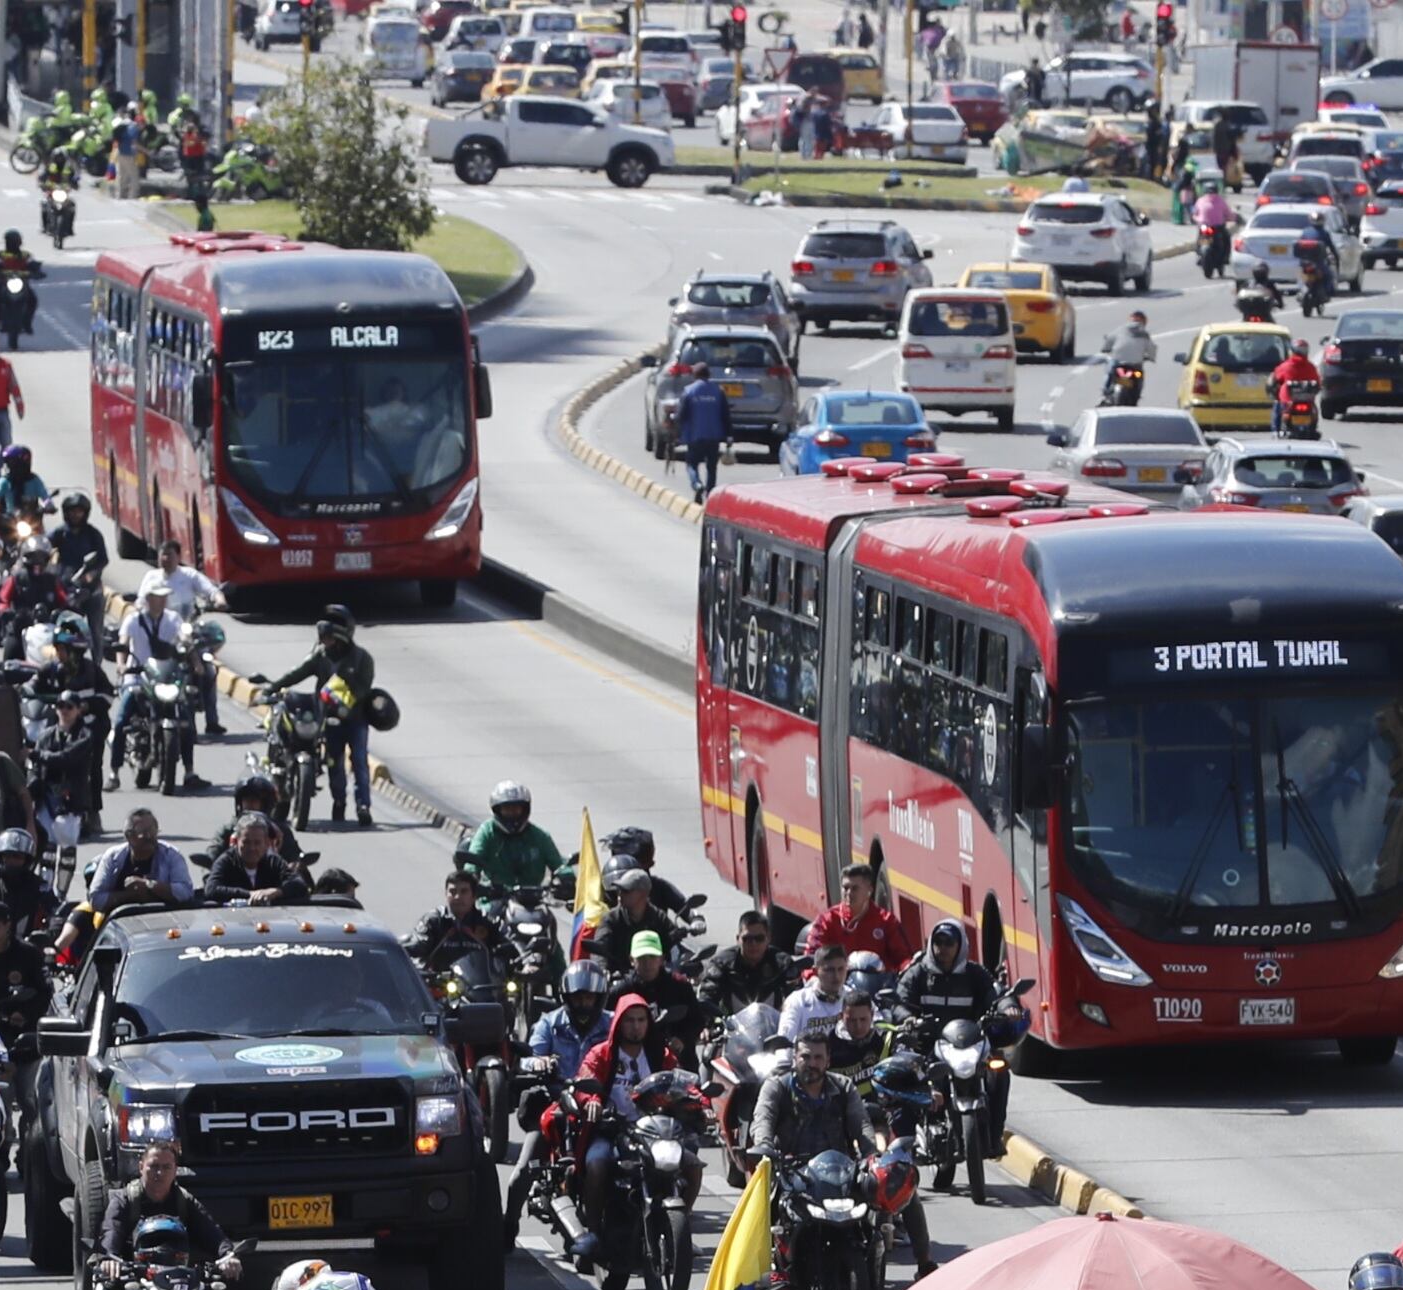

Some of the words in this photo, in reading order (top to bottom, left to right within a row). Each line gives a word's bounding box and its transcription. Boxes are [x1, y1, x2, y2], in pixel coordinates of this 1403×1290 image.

[258, 330, 295, 350] B23
[331, 326, 399, 347] ALCALA
[1154, 646, 1169, 671] 3
[1176, 641, 1268, 670] PORTAL
[1273, 640, 1348, 666] TUNAL
[1213, 921, 1312, 938] Marcopolo
[268, 943, 354, 961] Brothers
[1162, 964, 1209, 975] VOLVO
[1153, 997, 1203, 1018] T1090
[199, 1107, 396, 1133] FORD
[301, 1200, 331, 1218] 997
